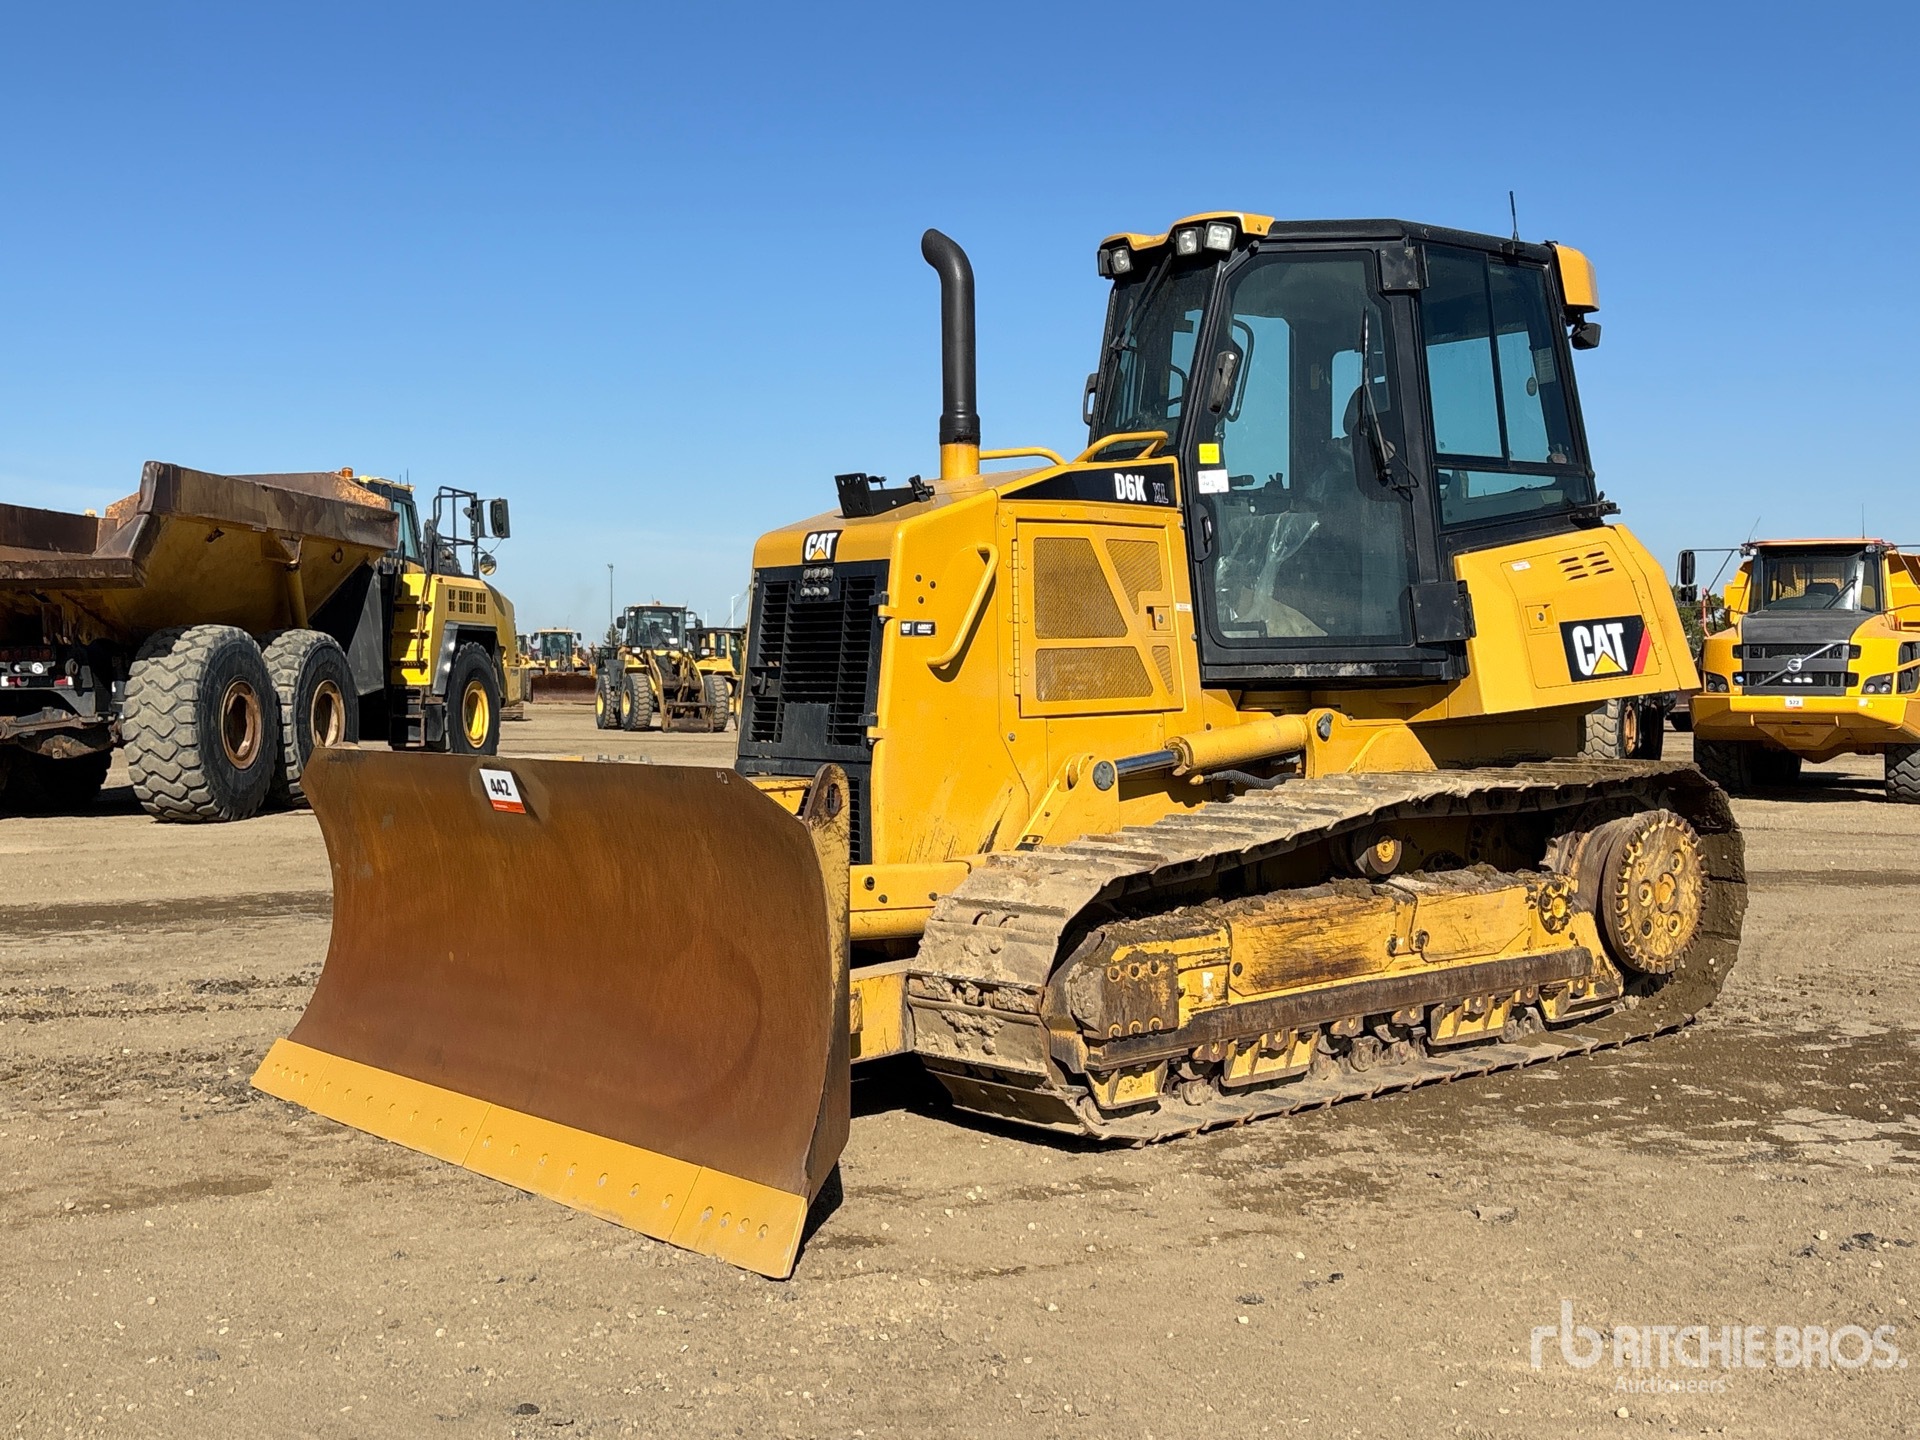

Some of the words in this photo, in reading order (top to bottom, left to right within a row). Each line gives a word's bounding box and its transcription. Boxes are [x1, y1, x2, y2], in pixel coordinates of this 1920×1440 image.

[1114, 473, 1147, 502] D6K
[1152, 482, 1169, 504] XL
[804, 532, 838, 561] CAT
[1572, 622, 1628, 676] CAT
[490, 778, 512, 796] 442
